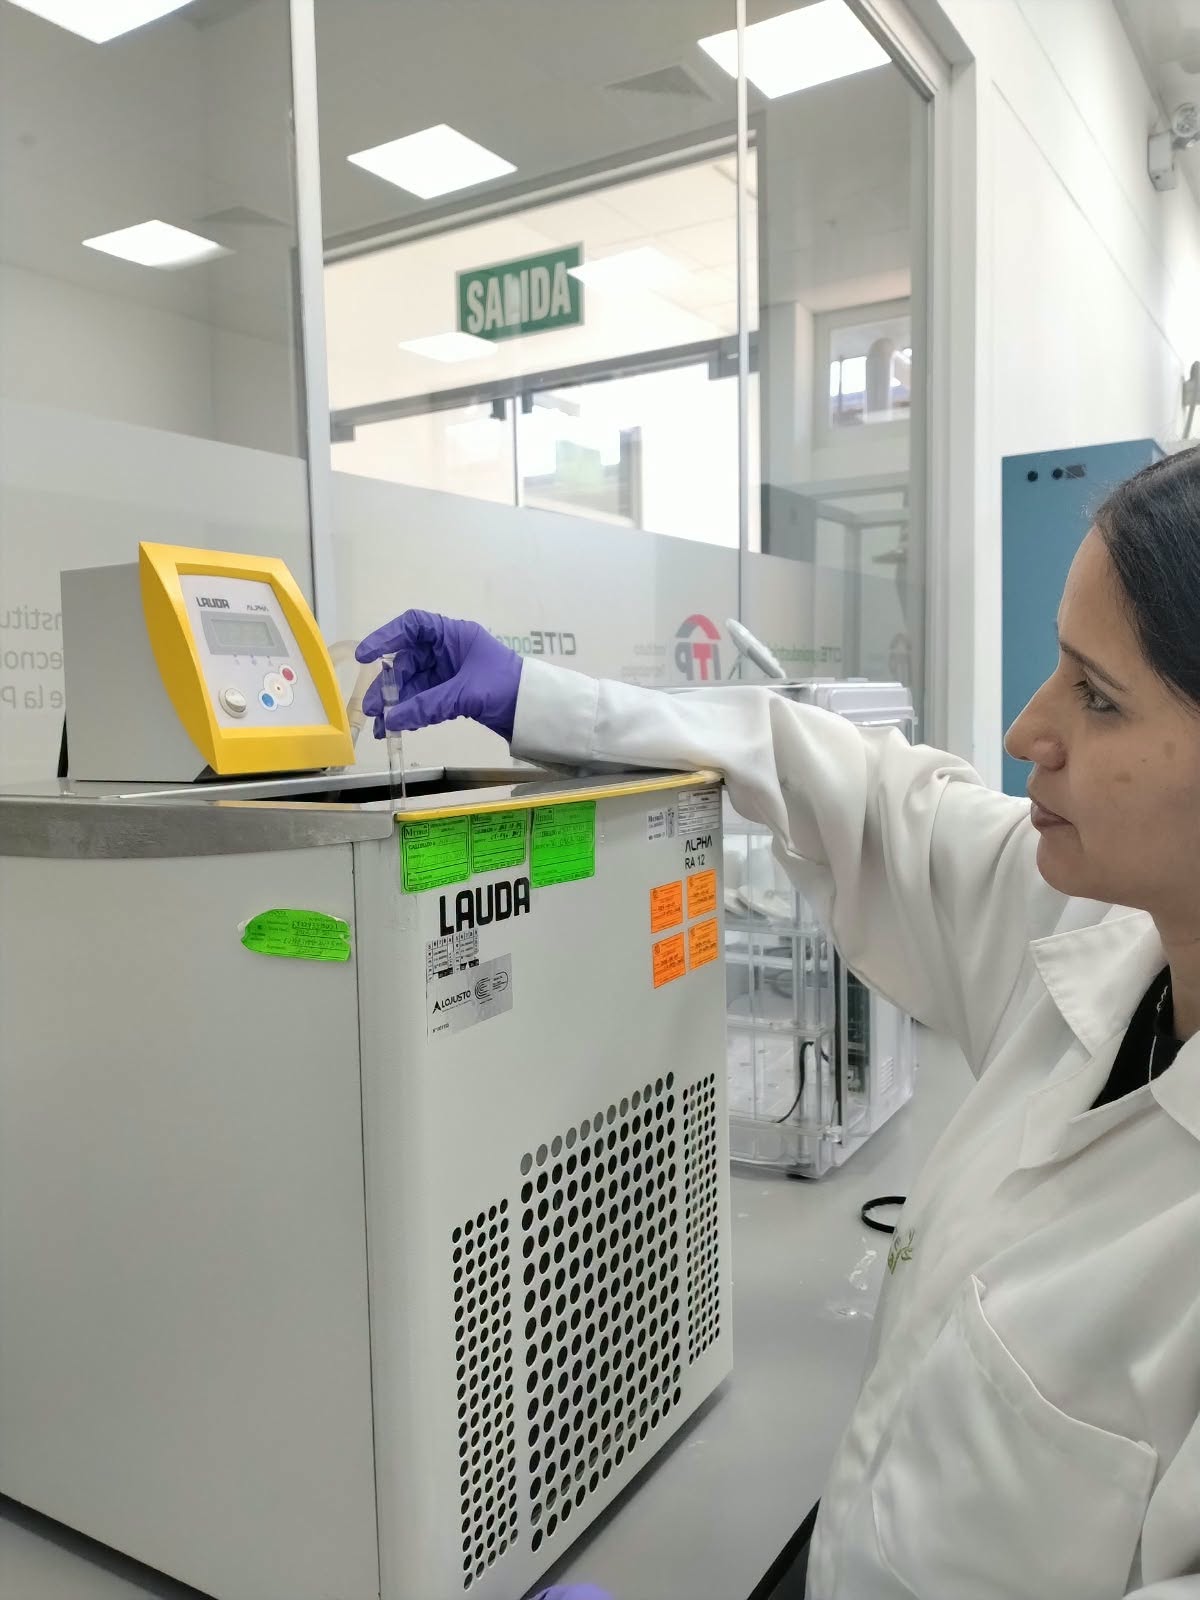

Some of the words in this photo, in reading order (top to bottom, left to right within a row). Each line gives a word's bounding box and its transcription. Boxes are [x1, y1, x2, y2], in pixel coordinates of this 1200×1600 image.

[466, 261, 572, 334] SALIDA
[196, 597, 230, 609] LAUDA
[685, 834, 713, 853] ALPHA
[685, 857, 695, 869] RA
[698, 854, 705, 866] 12
[439, 876, 531, 937] LAUDA
